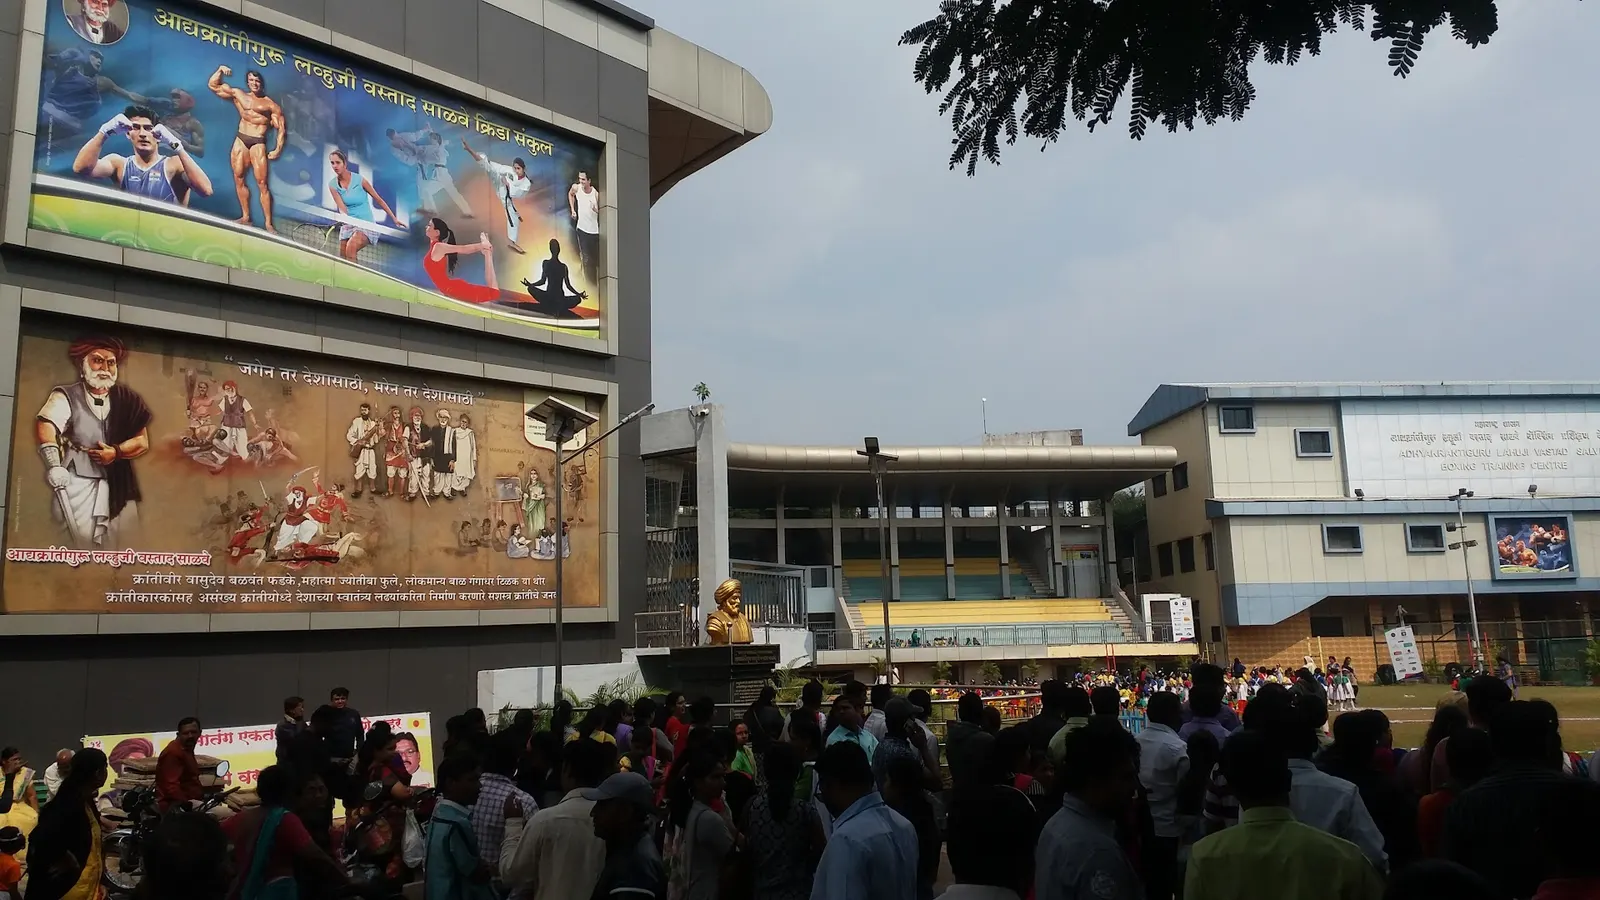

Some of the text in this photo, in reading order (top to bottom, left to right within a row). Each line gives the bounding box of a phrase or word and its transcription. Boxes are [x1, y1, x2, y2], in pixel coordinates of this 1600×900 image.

[153, 7, 555, 157] आद्यक्रांतीगुरू लव्हुजी वस्ताद साळवे क्रिडा संकुल
[280, 366, 298, 383] तर
[373, 378, 399, 396] मरेन
[403, 384, 419, 399] तर
[1496, 448, 1529, 457] LAHUJI
[1534, 448, 1568, 456] VASTAD
[1441, 461, 1568, 471] BOXING TRAINING CENTRE
[6, 545, 212, 567] आद्यक्रांतीगुरू लव्हुजी वस्ताद साळवे
[132, 571, 182, 586] क्रांतीवीर
[185, 571, 225, 589] वासुदेव
[229, 572, 264, 586] बळवंत
[339, 573, 377, 586] ज्योतीबा
[405, 573, 446, 586] लोकमान्य
[449, 576, 467, 586] बाळ
[469, 574, 495, 586] गंगाधर
[497, 574, 519, 586] टिळक
[521, 577, 531, 586] या
[533, 574, 546, 586] थोर
[105, 589, 193, 604] क्रांतीकारकांसह
[198, 590, 237, 604] असंख्य
[296, 589, 334, 603] देशाच्या
[336, 589, 371, 602] स्वातंत्र्य
[429, 589, 456, 602] निर्माण
[458, 589, 486, 602] करणारे
[488, 591, 511, 601] सशस्त्र
[513, 588, 539, 601] क्रांतीचे
